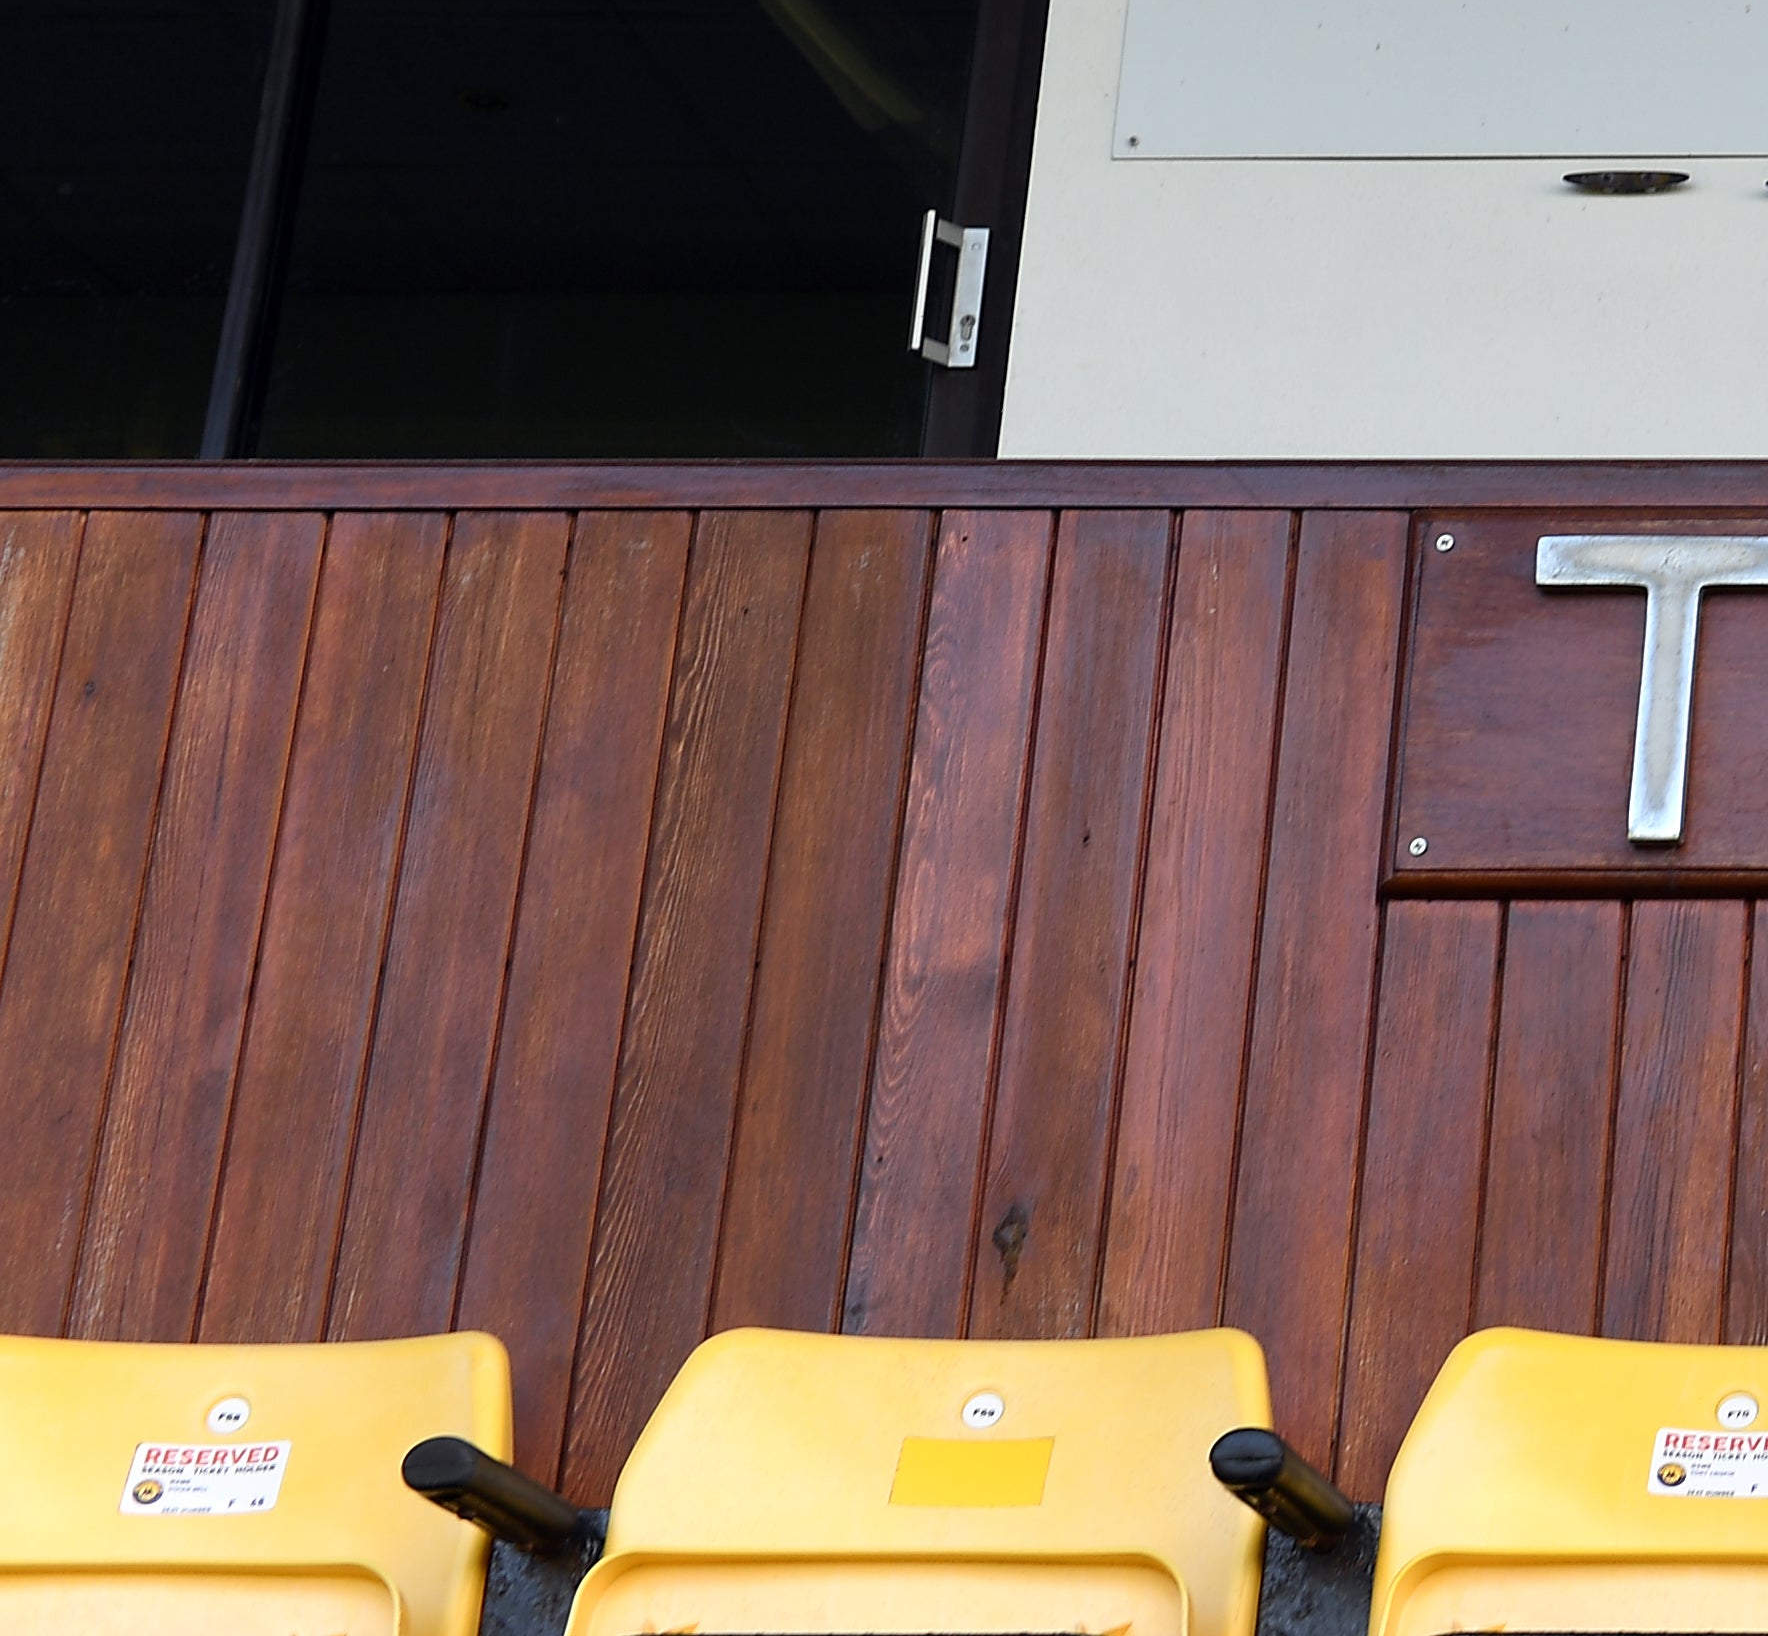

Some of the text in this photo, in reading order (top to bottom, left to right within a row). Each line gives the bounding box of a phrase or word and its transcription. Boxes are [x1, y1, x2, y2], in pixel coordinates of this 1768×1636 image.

[144, 1446, 279, 1465] RESERVED
[1663, 1450, 1703, 1460] SEASON
[1713, 1452, 1747, 1461] TICKET
[141, 1465, 184, 1475] SEASON
[194, 1467, 230, 1475] TICKET
